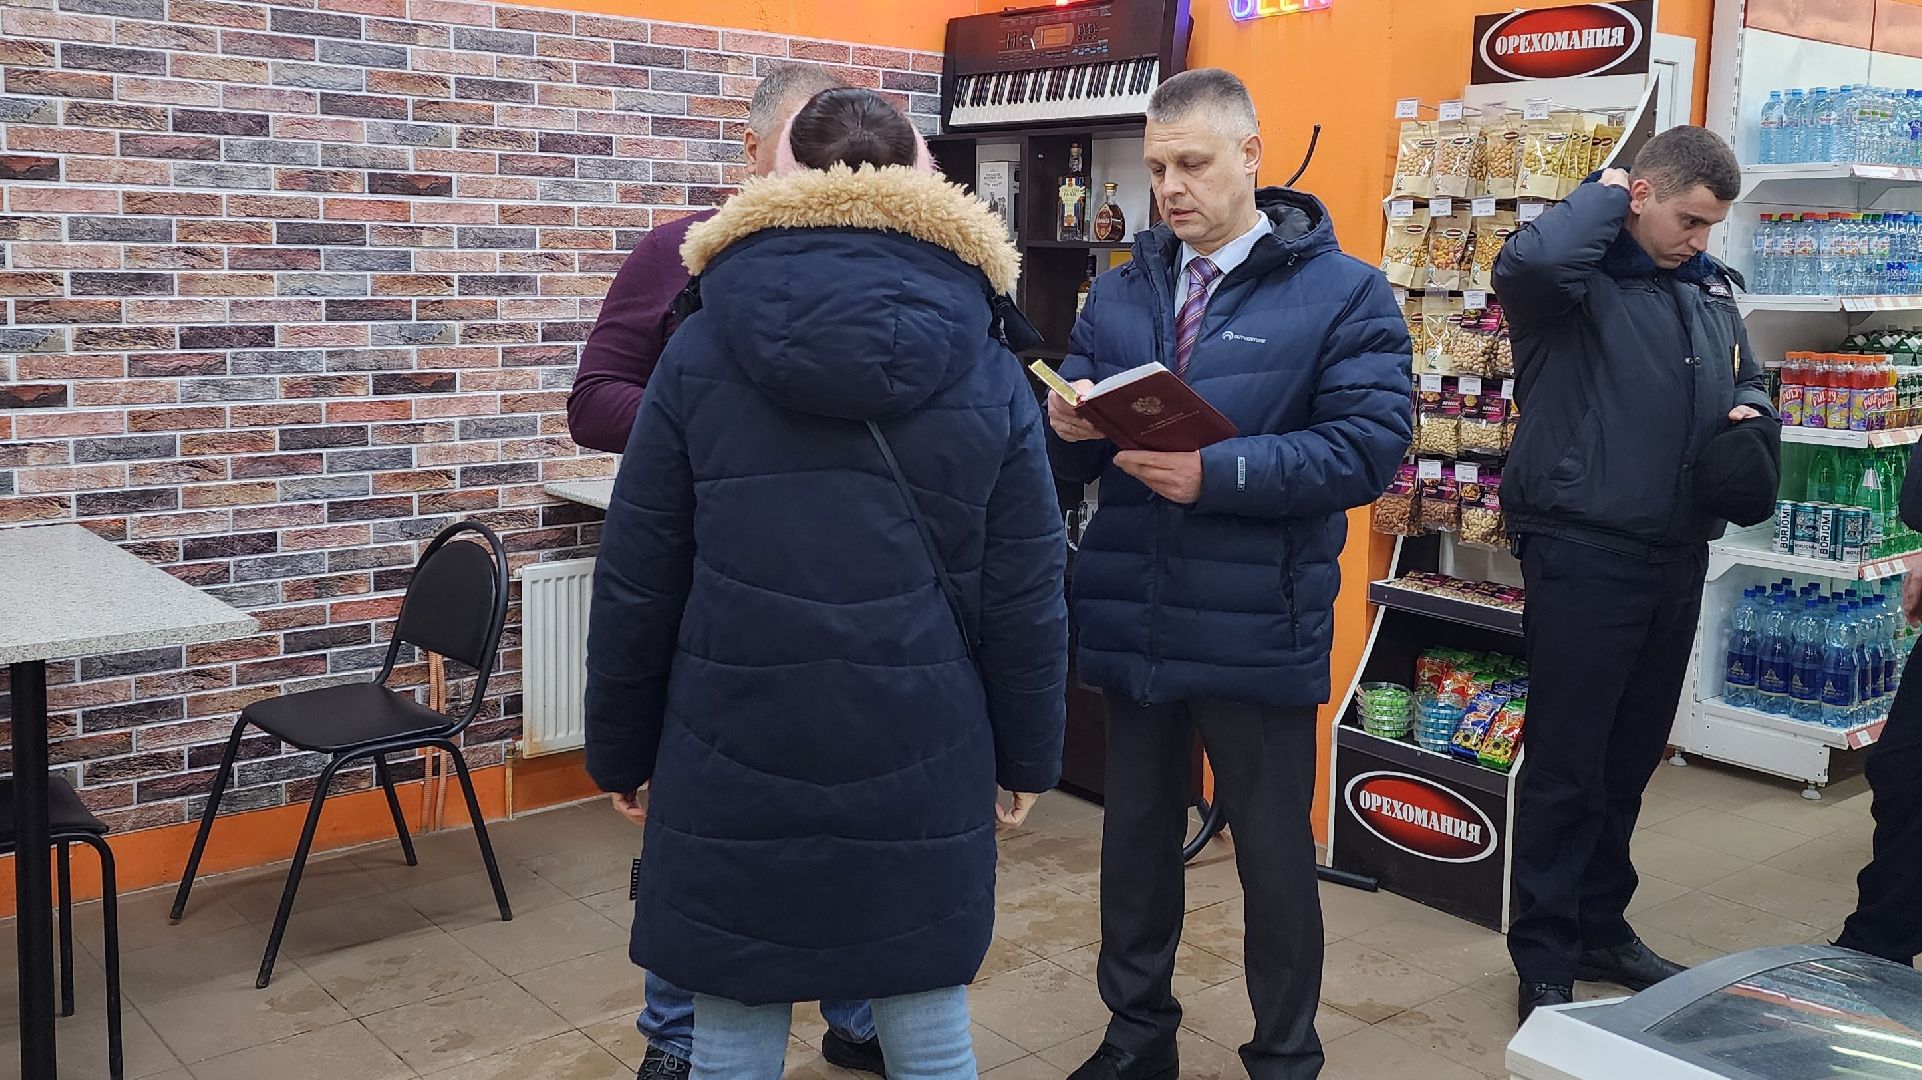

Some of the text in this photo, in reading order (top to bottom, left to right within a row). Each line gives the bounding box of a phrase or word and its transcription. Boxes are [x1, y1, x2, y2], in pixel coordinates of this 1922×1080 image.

[1495, 26, 1626, 56] ОРЕХОМАНИЯ
[1780, 507, 1791, 549] BORJOMI
[1820, 512, 1831, 555] BORJOMI
[1359, 789, 1482, 845] ОРЕХОМАНИЯ
